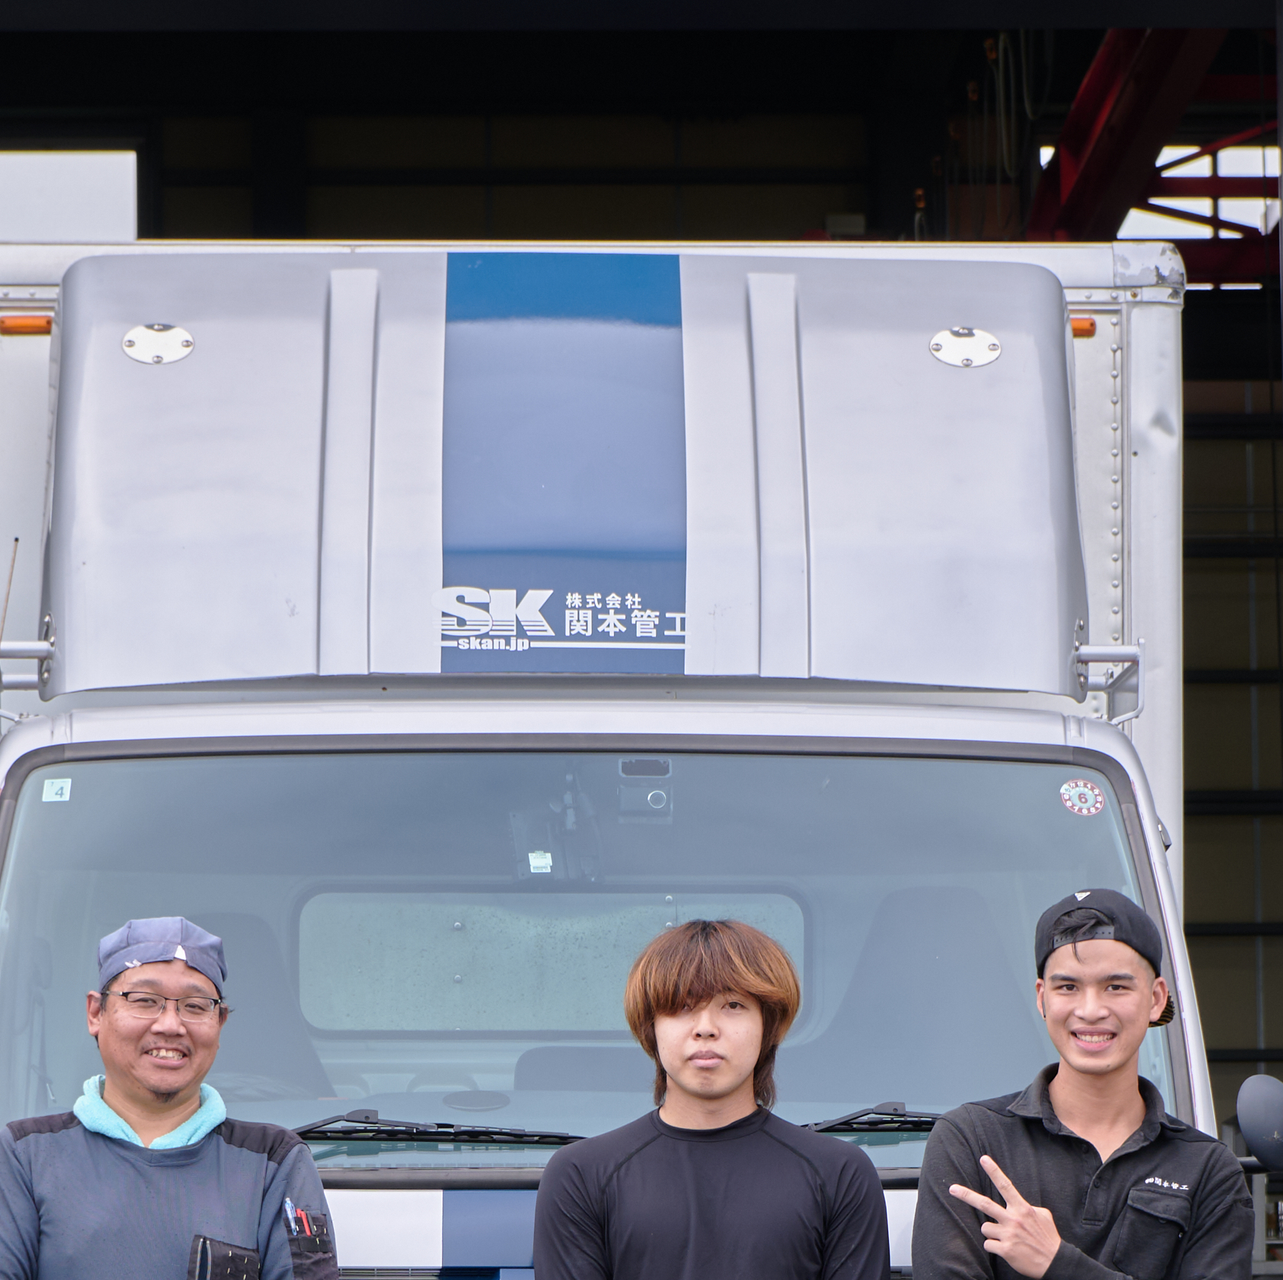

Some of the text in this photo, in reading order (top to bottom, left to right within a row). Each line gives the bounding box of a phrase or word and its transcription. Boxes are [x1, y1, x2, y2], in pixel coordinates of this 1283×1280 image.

[565, 592, 643, 610] 株式会社
[431, 586, 555, 637] SK
[564, 609, 691, 638] 関本管工
[457, 635, 531, 652] skan.jp
[55, 786, 65, 798] 4
[1078, 793, 1088, 804] 6
